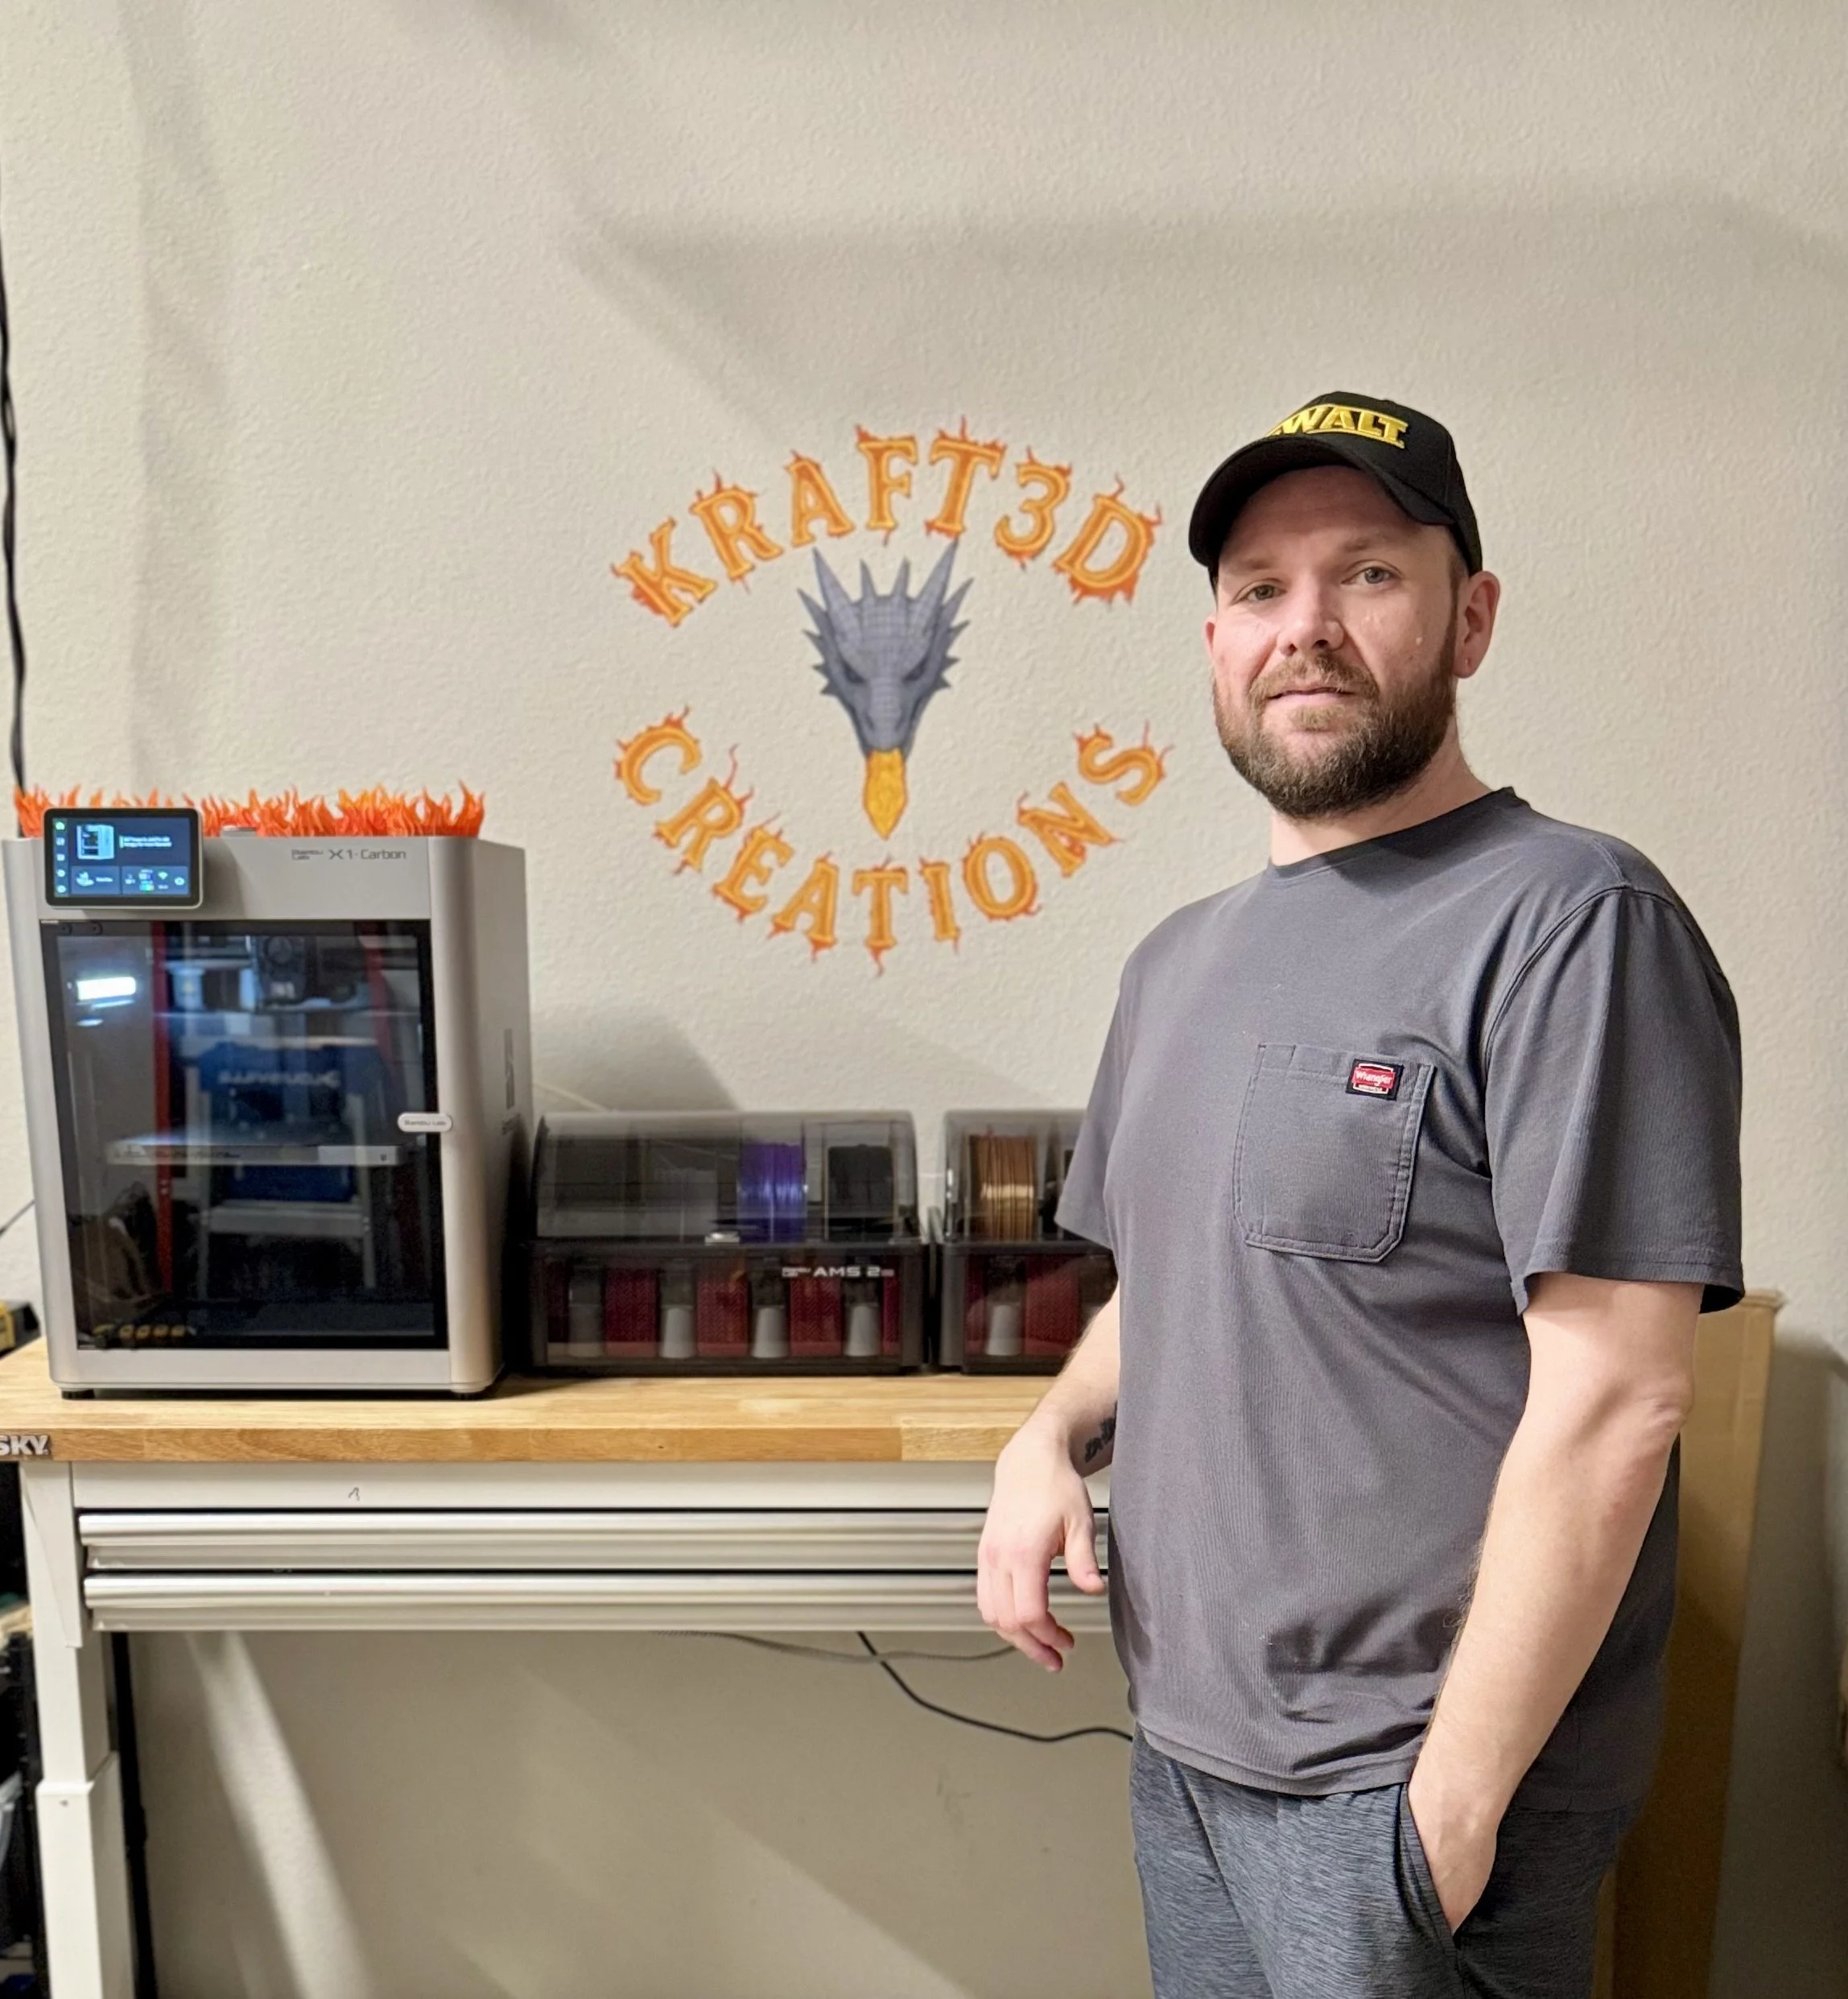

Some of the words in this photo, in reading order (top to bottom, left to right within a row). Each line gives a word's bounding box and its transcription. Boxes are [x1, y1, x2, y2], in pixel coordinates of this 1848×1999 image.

[1266, 404, 1408, 448] WALT
[612, 417, 1161, 628] KRAFT3D
[614, 705, 1174, 976] CREATIONS
[1355, 1071, 1393, 1086] Wrangler
[813, 1266, 860, 1277] AMS
[866, 1266, 881, 1277] 2
